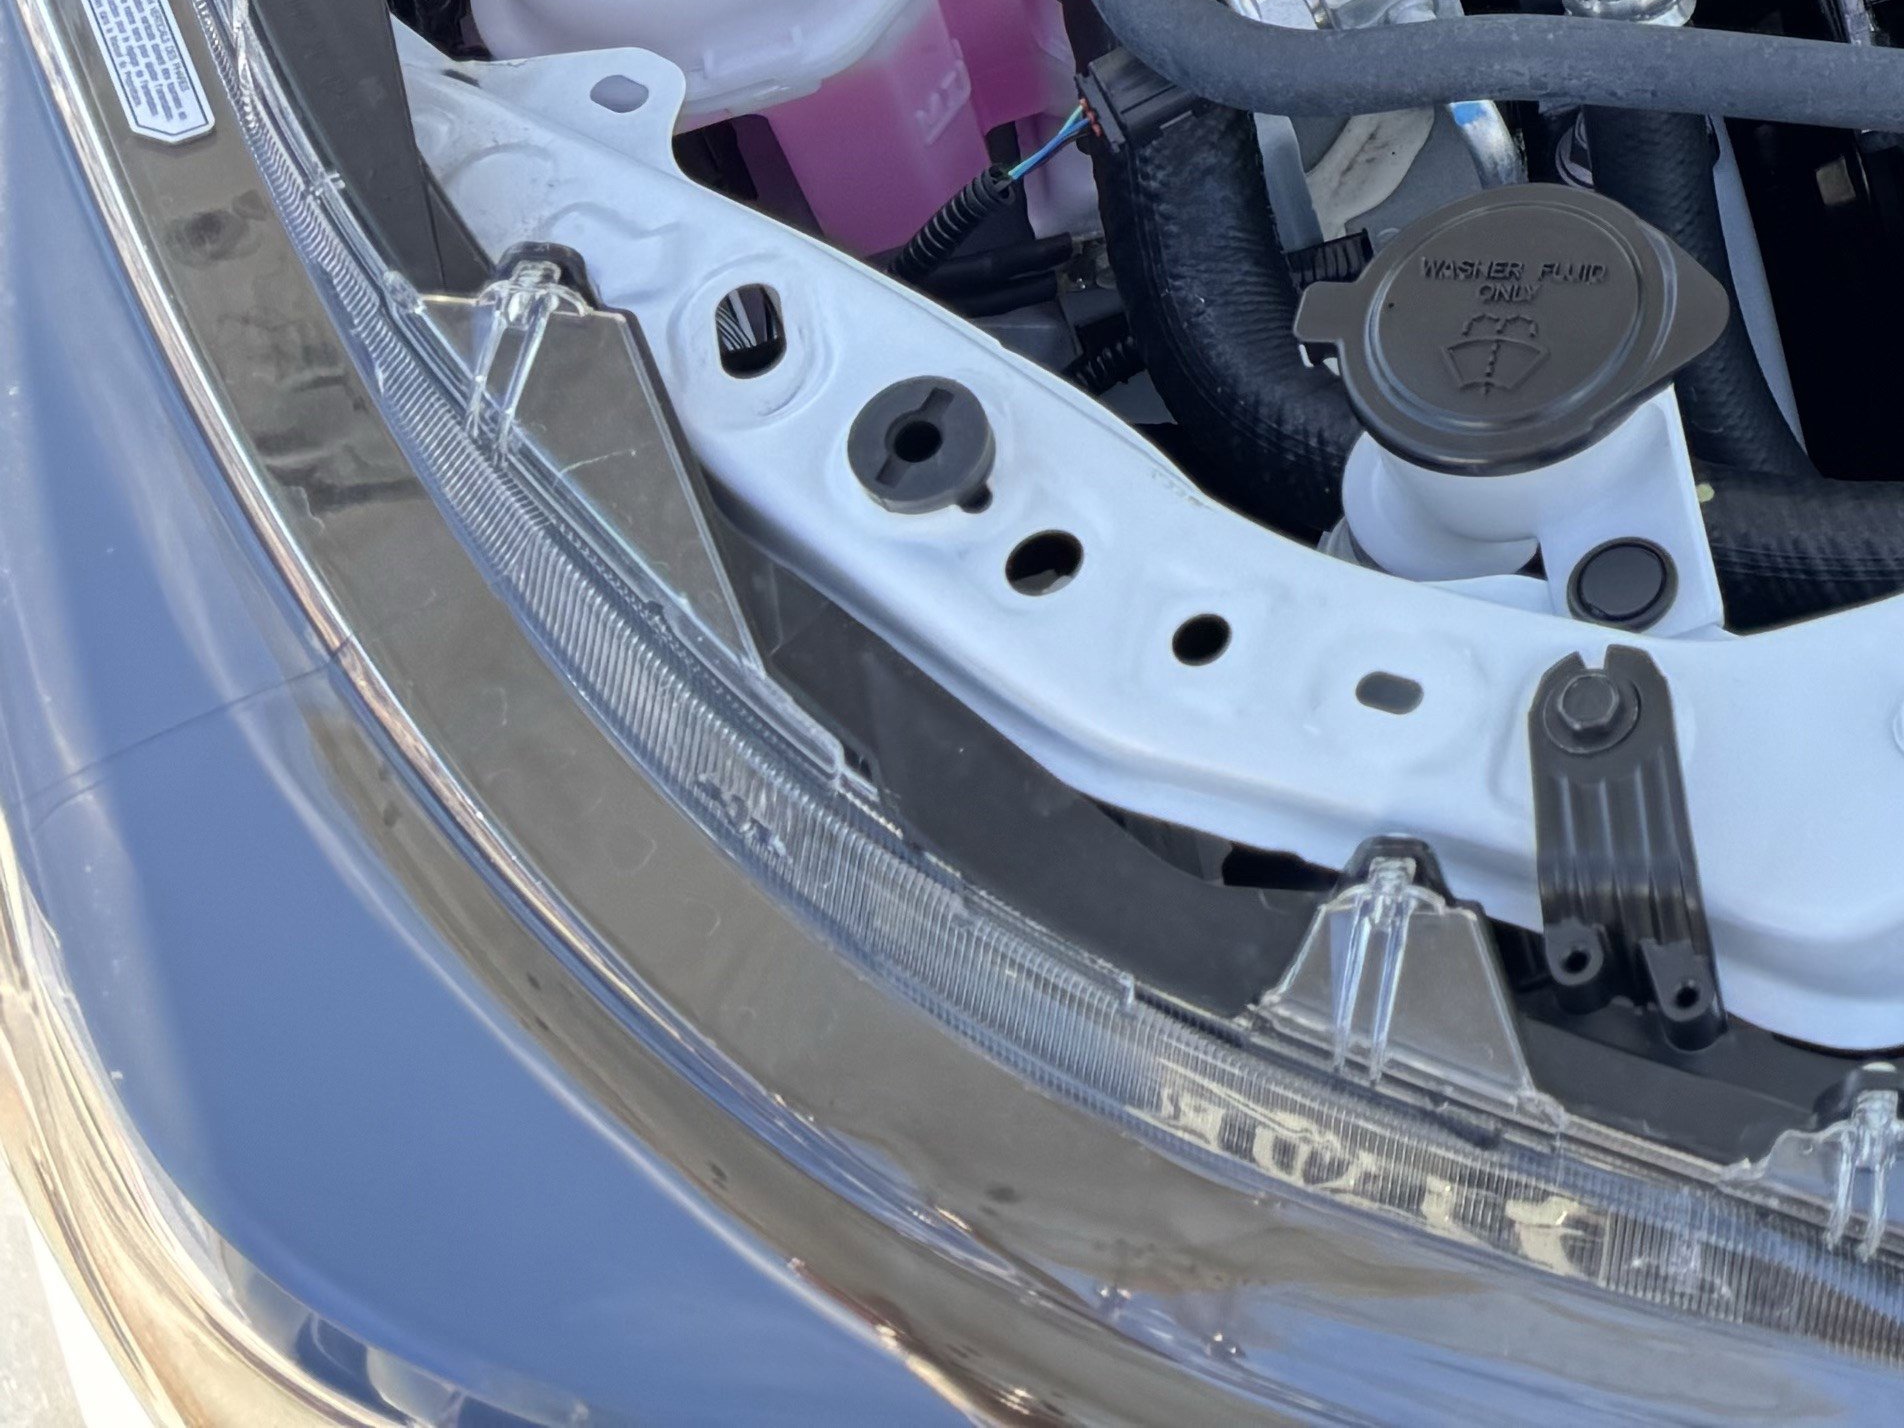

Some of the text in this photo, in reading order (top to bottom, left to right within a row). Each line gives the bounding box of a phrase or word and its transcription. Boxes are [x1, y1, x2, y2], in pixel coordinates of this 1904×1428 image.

[1420, 256, 1608, 285] WASHER FLUID
[1477, 281, 1542, 304] ONLY
